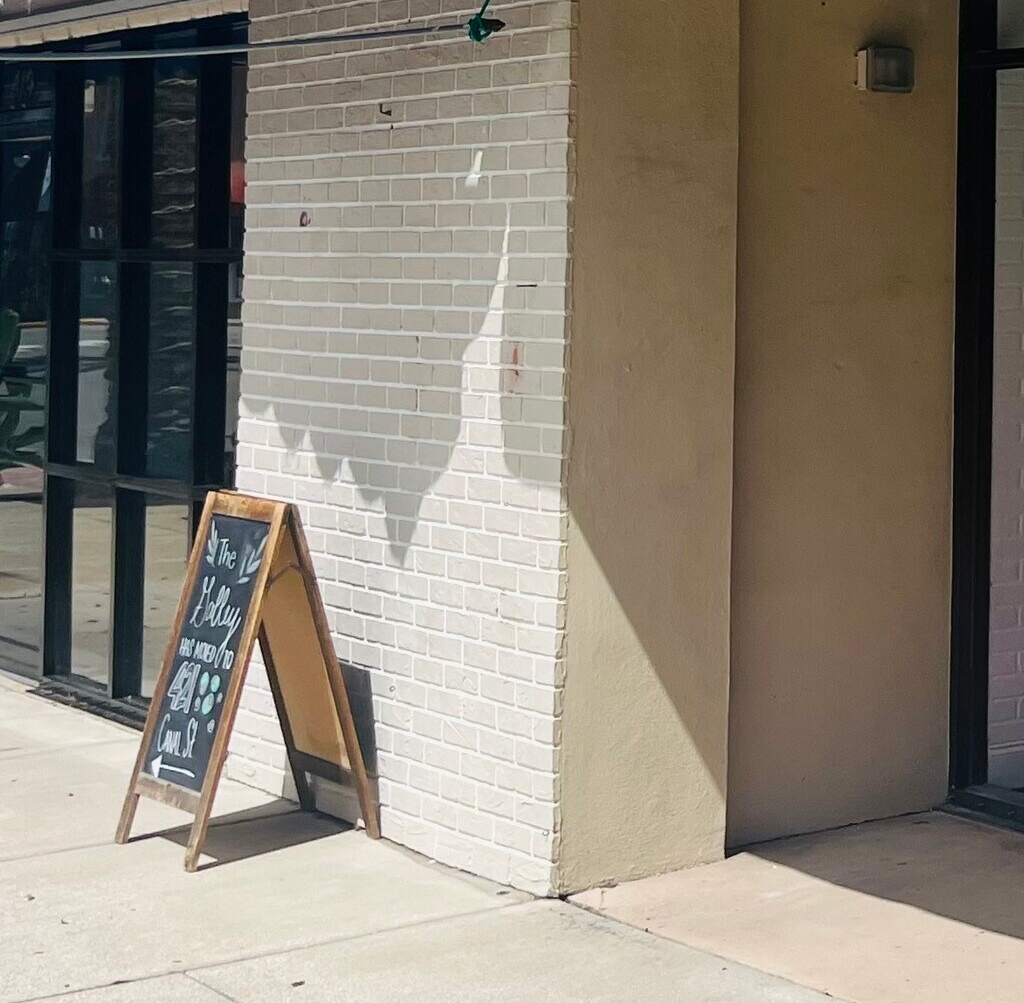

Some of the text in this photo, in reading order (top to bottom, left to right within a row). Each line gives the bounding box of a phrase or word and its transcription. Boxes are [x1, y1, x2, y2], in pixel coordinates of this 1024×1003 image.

[218, 537, 237, 570] The
[179, 637, 196, 657] HAS
[222, 649, 235, 670] TO
